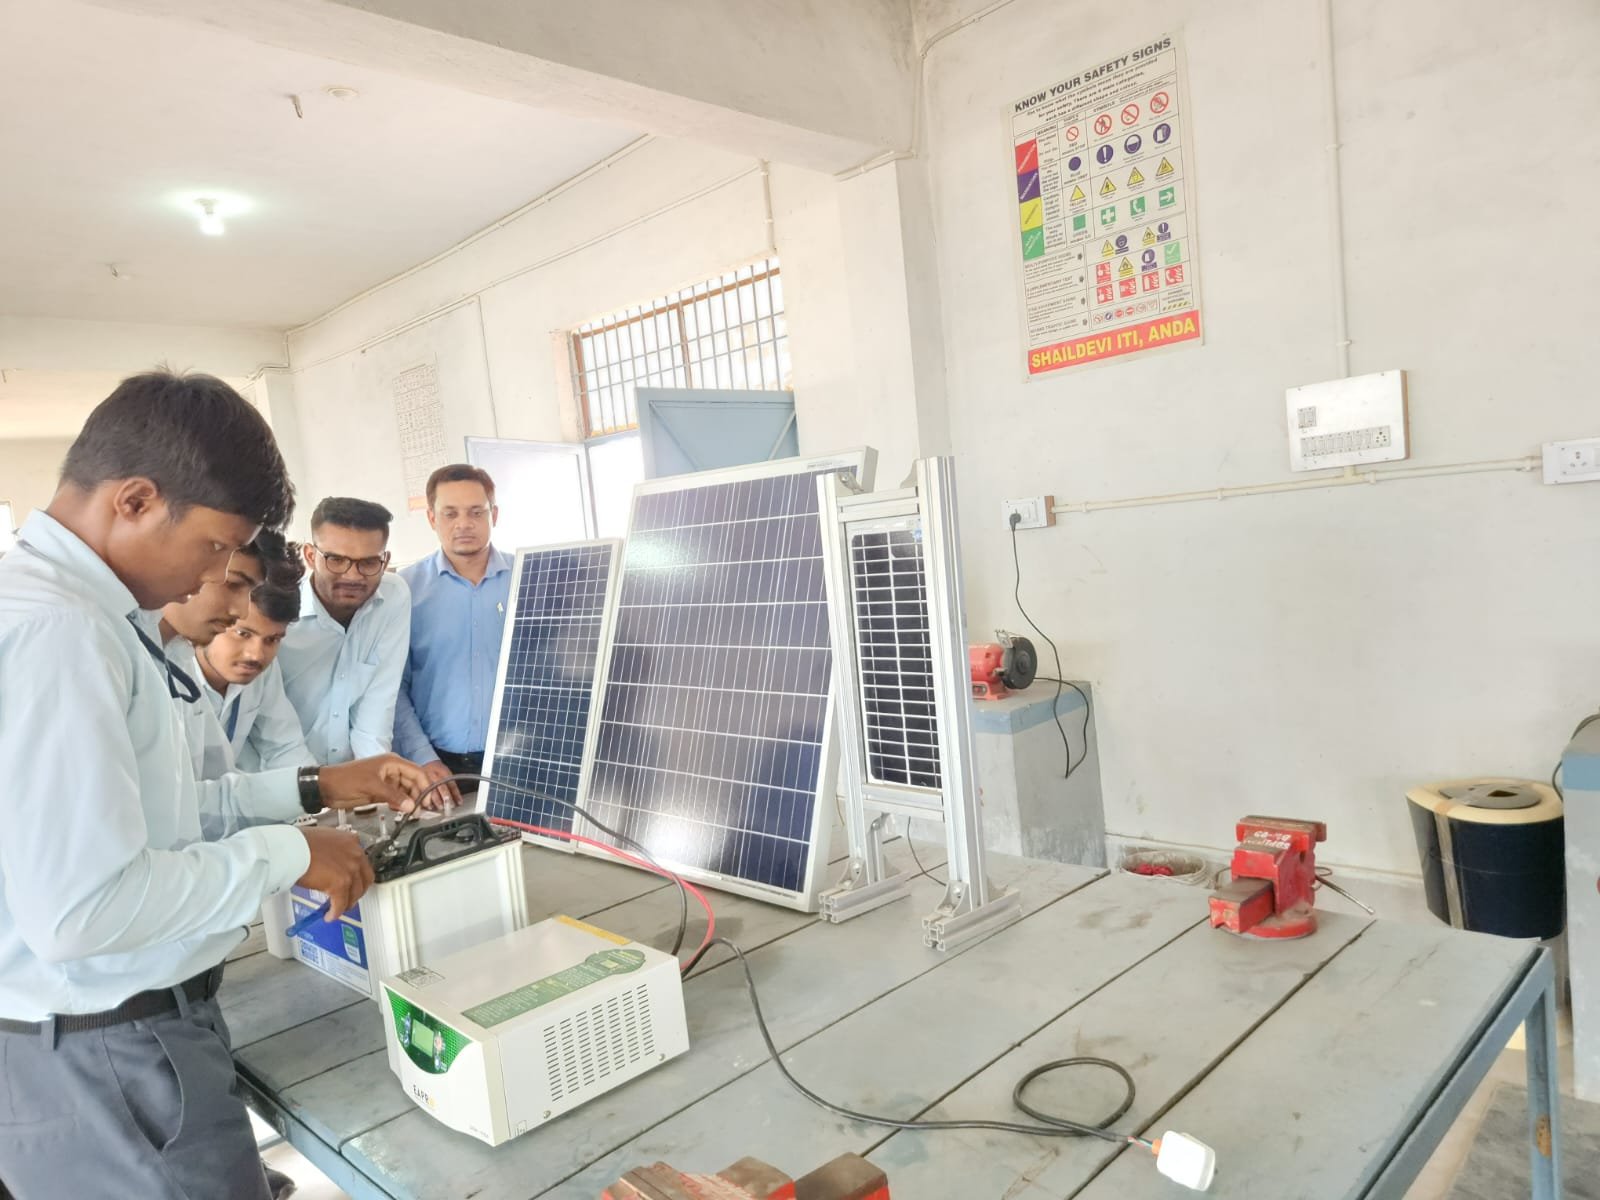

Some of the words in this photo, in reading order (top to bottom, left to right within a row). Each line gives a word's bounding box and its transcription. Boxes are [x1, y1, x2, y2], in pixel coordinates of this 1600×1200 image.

[1014, 91, 1047, 113] KNOW
[1049, 77, 1081, 96] YOUR
[1084, 56, 1128, 82] SAFETY
[1132, 38, 1171, 61] SIGNS
[1055, 95, 1066, 104] what
[1074, 93, 1087, 103] There
[1031, 337, 1112, 368] SHAILDEVI
[1117, 330, 1144, 348] ITI,
[1149, 318, 1195, 342] ANDA
